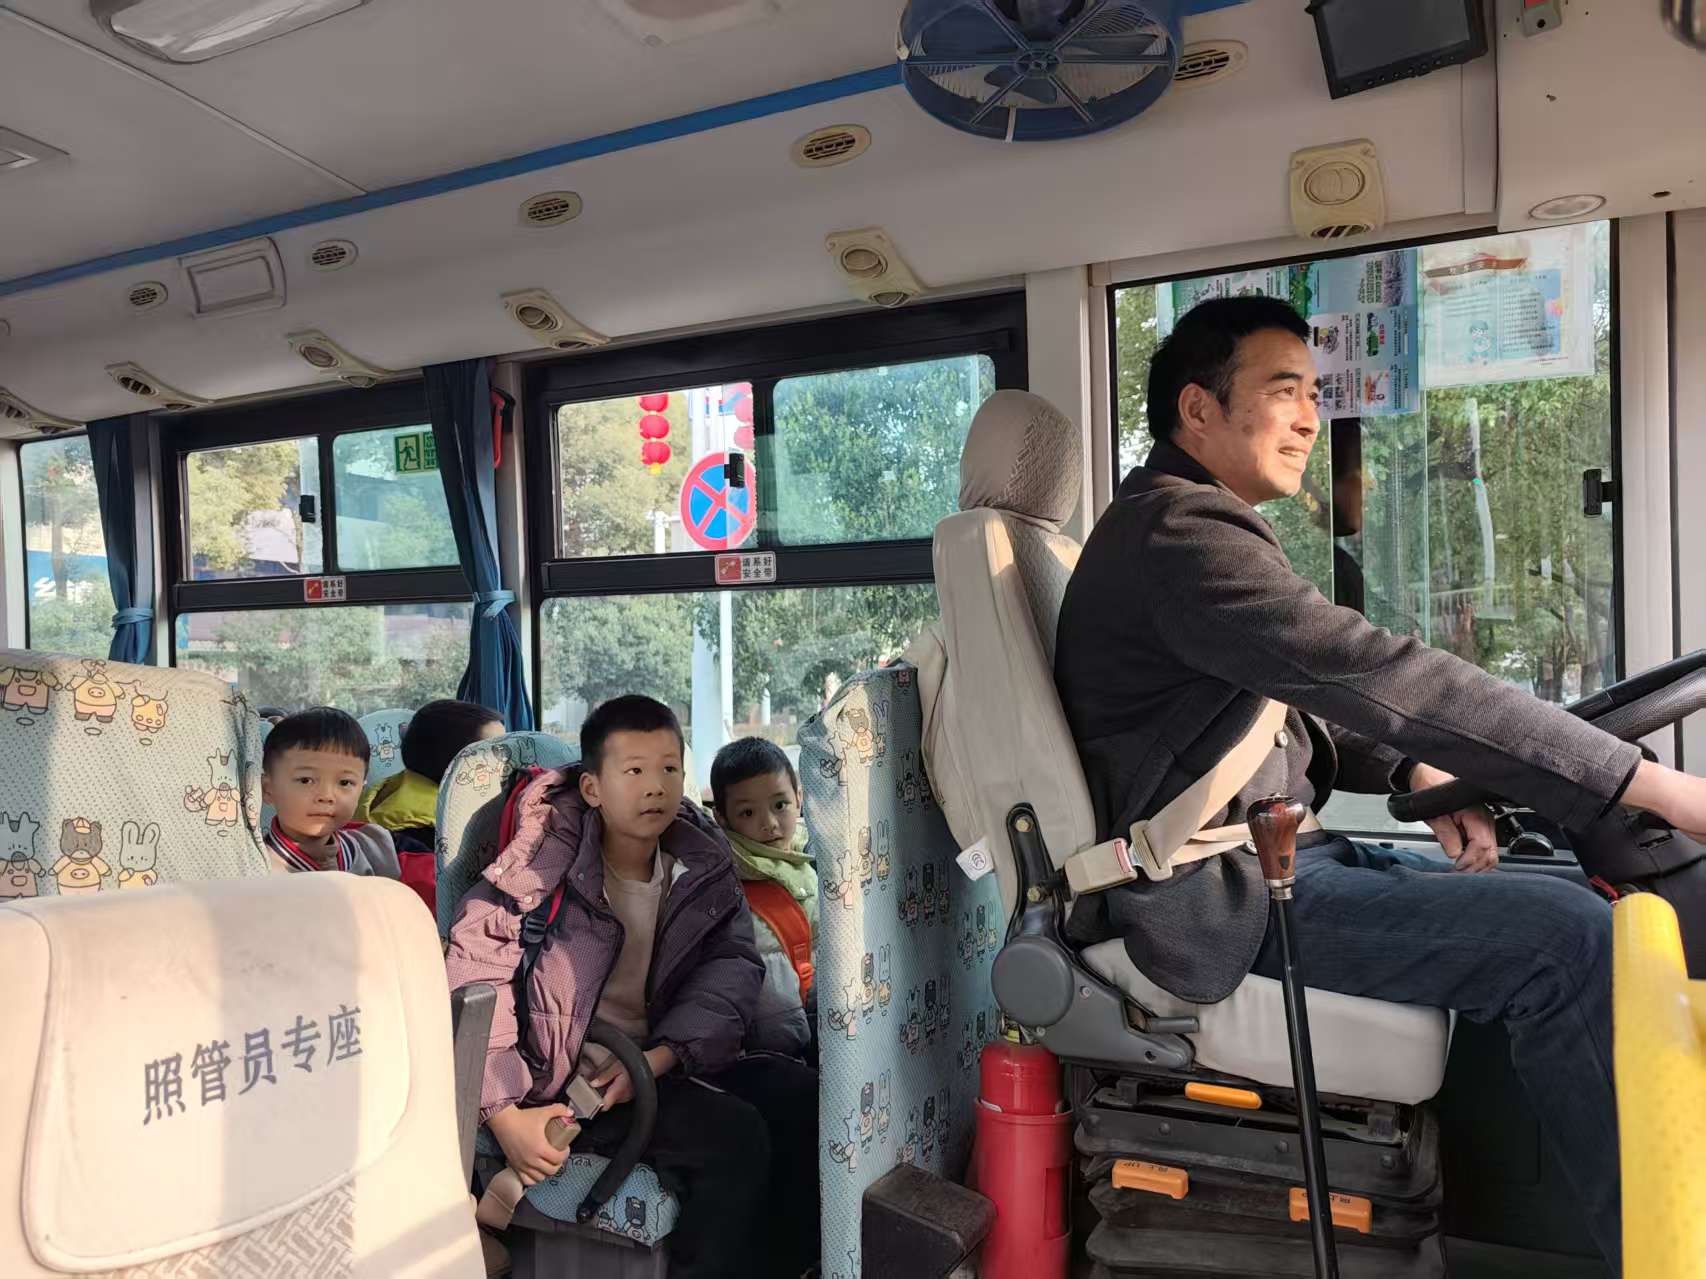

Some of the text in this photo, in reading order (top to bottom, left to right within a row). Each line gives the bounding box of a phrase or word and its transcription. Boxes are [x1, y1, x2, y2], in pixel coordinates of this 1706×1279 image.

[742, 568, 773, 579] 安全带
[143, 1004, 363, 1126] 照管员专座
